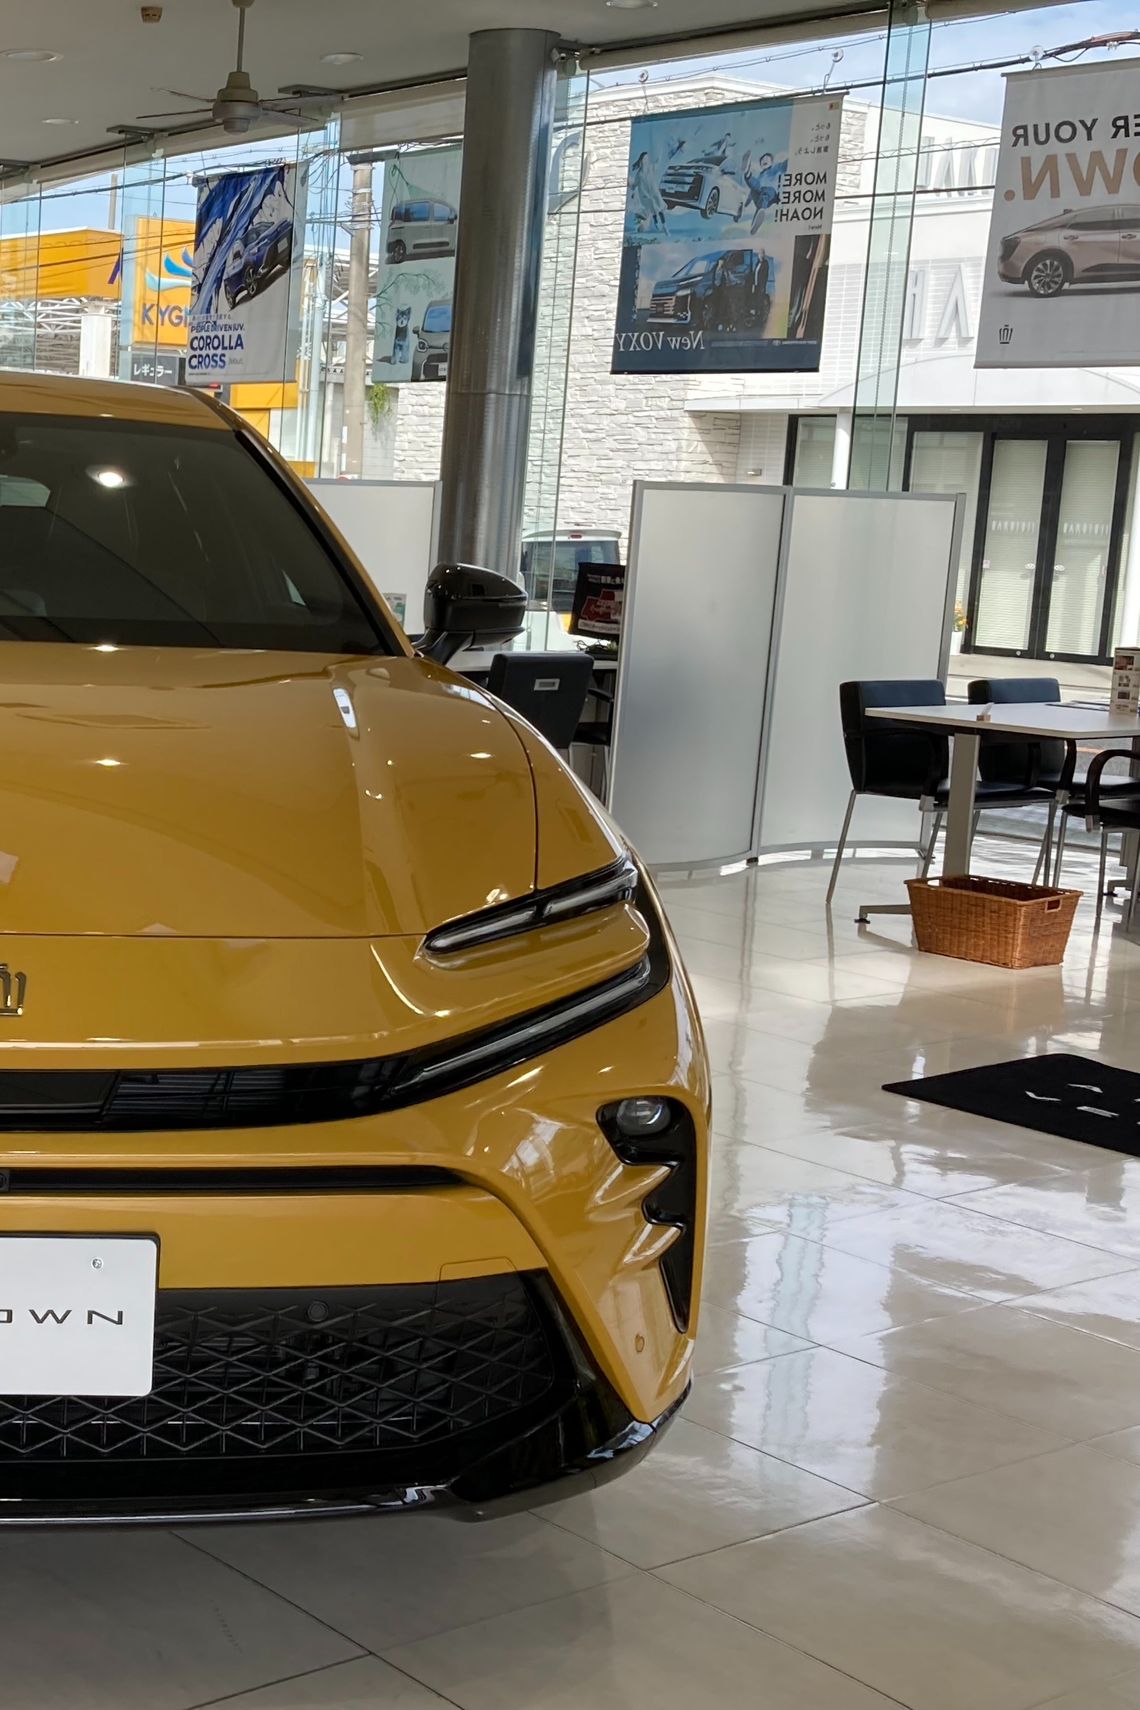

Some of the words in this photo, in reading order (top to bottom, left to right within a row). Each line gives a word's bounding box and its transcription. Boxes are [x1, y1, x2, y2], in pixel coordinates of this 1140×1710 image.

[189, 334, 244, 351] COROLLA
[133, 363, 173, 377] レギュラー
[188, 353, 226, 370] CROSS
